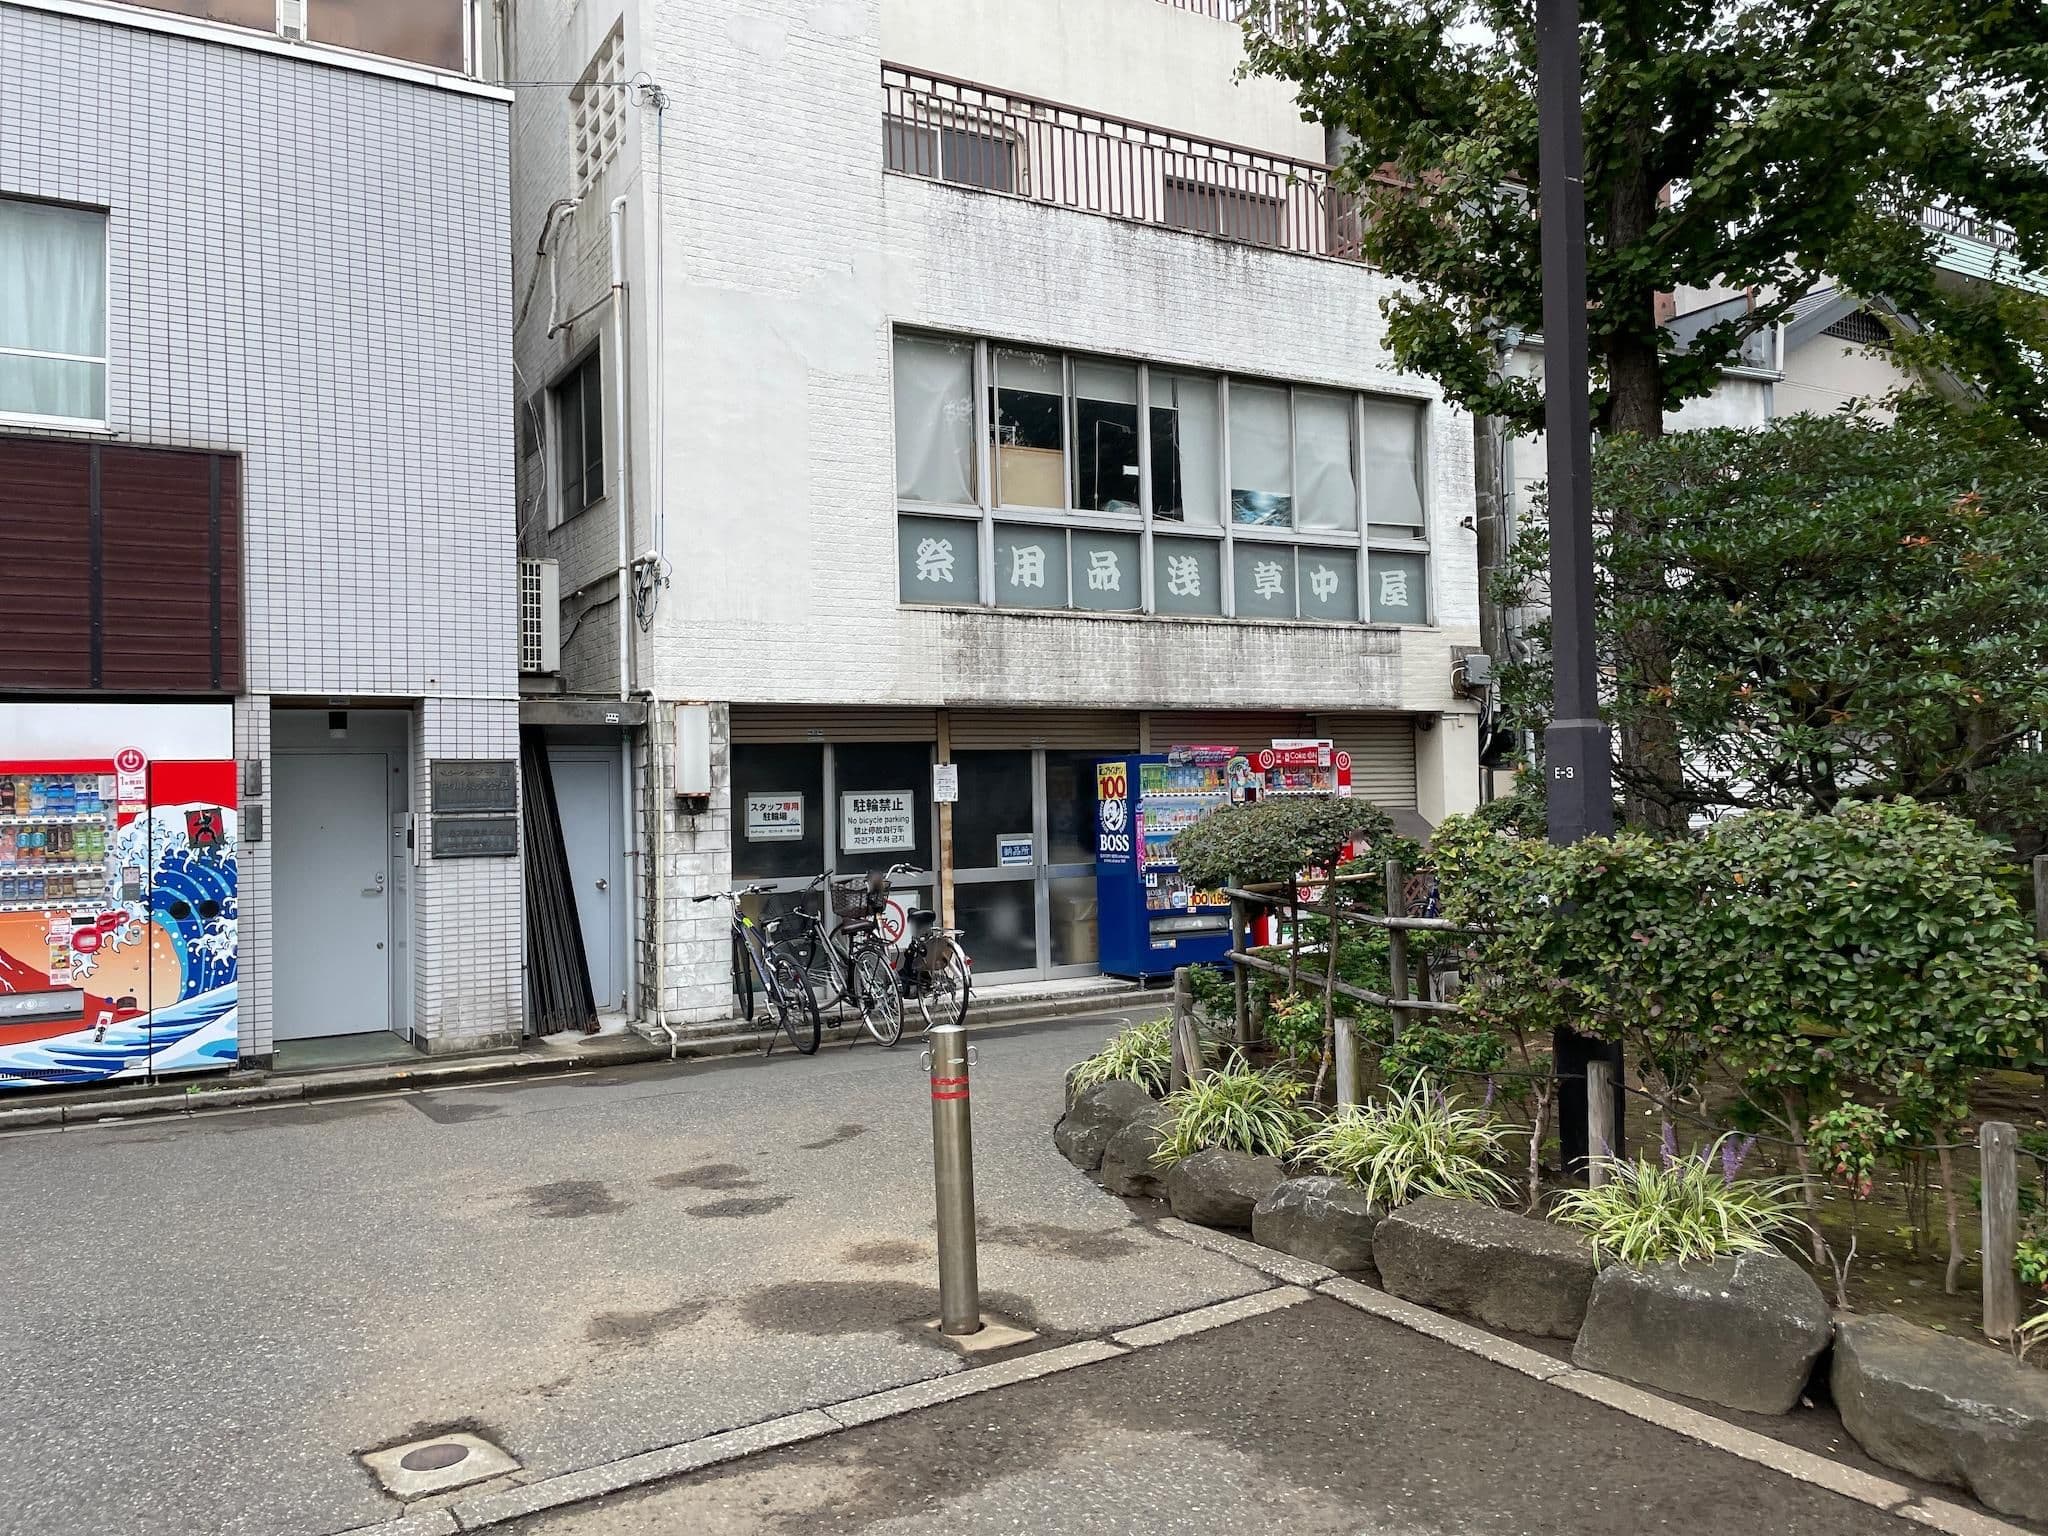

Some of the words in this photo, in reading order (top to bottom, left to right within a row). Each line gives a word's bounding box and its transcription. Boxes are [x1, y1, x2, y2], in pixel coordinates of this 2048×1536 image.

[915, 536, 1409, 608] 祭用品浅草中屋
[1554, 767, 1574, 779] E-3
[1100, 775, 1126, 799] 100
[750, 802, 799, 812] スタッフ専用
[853, 797, 905, 813] 駐輪禁止
[847, 816, 858, 825] No
[859, 815, 883, 826] bicycle
[884, 816, 910, 825] parking
[1099, 834, 1130, 852] BOSS
